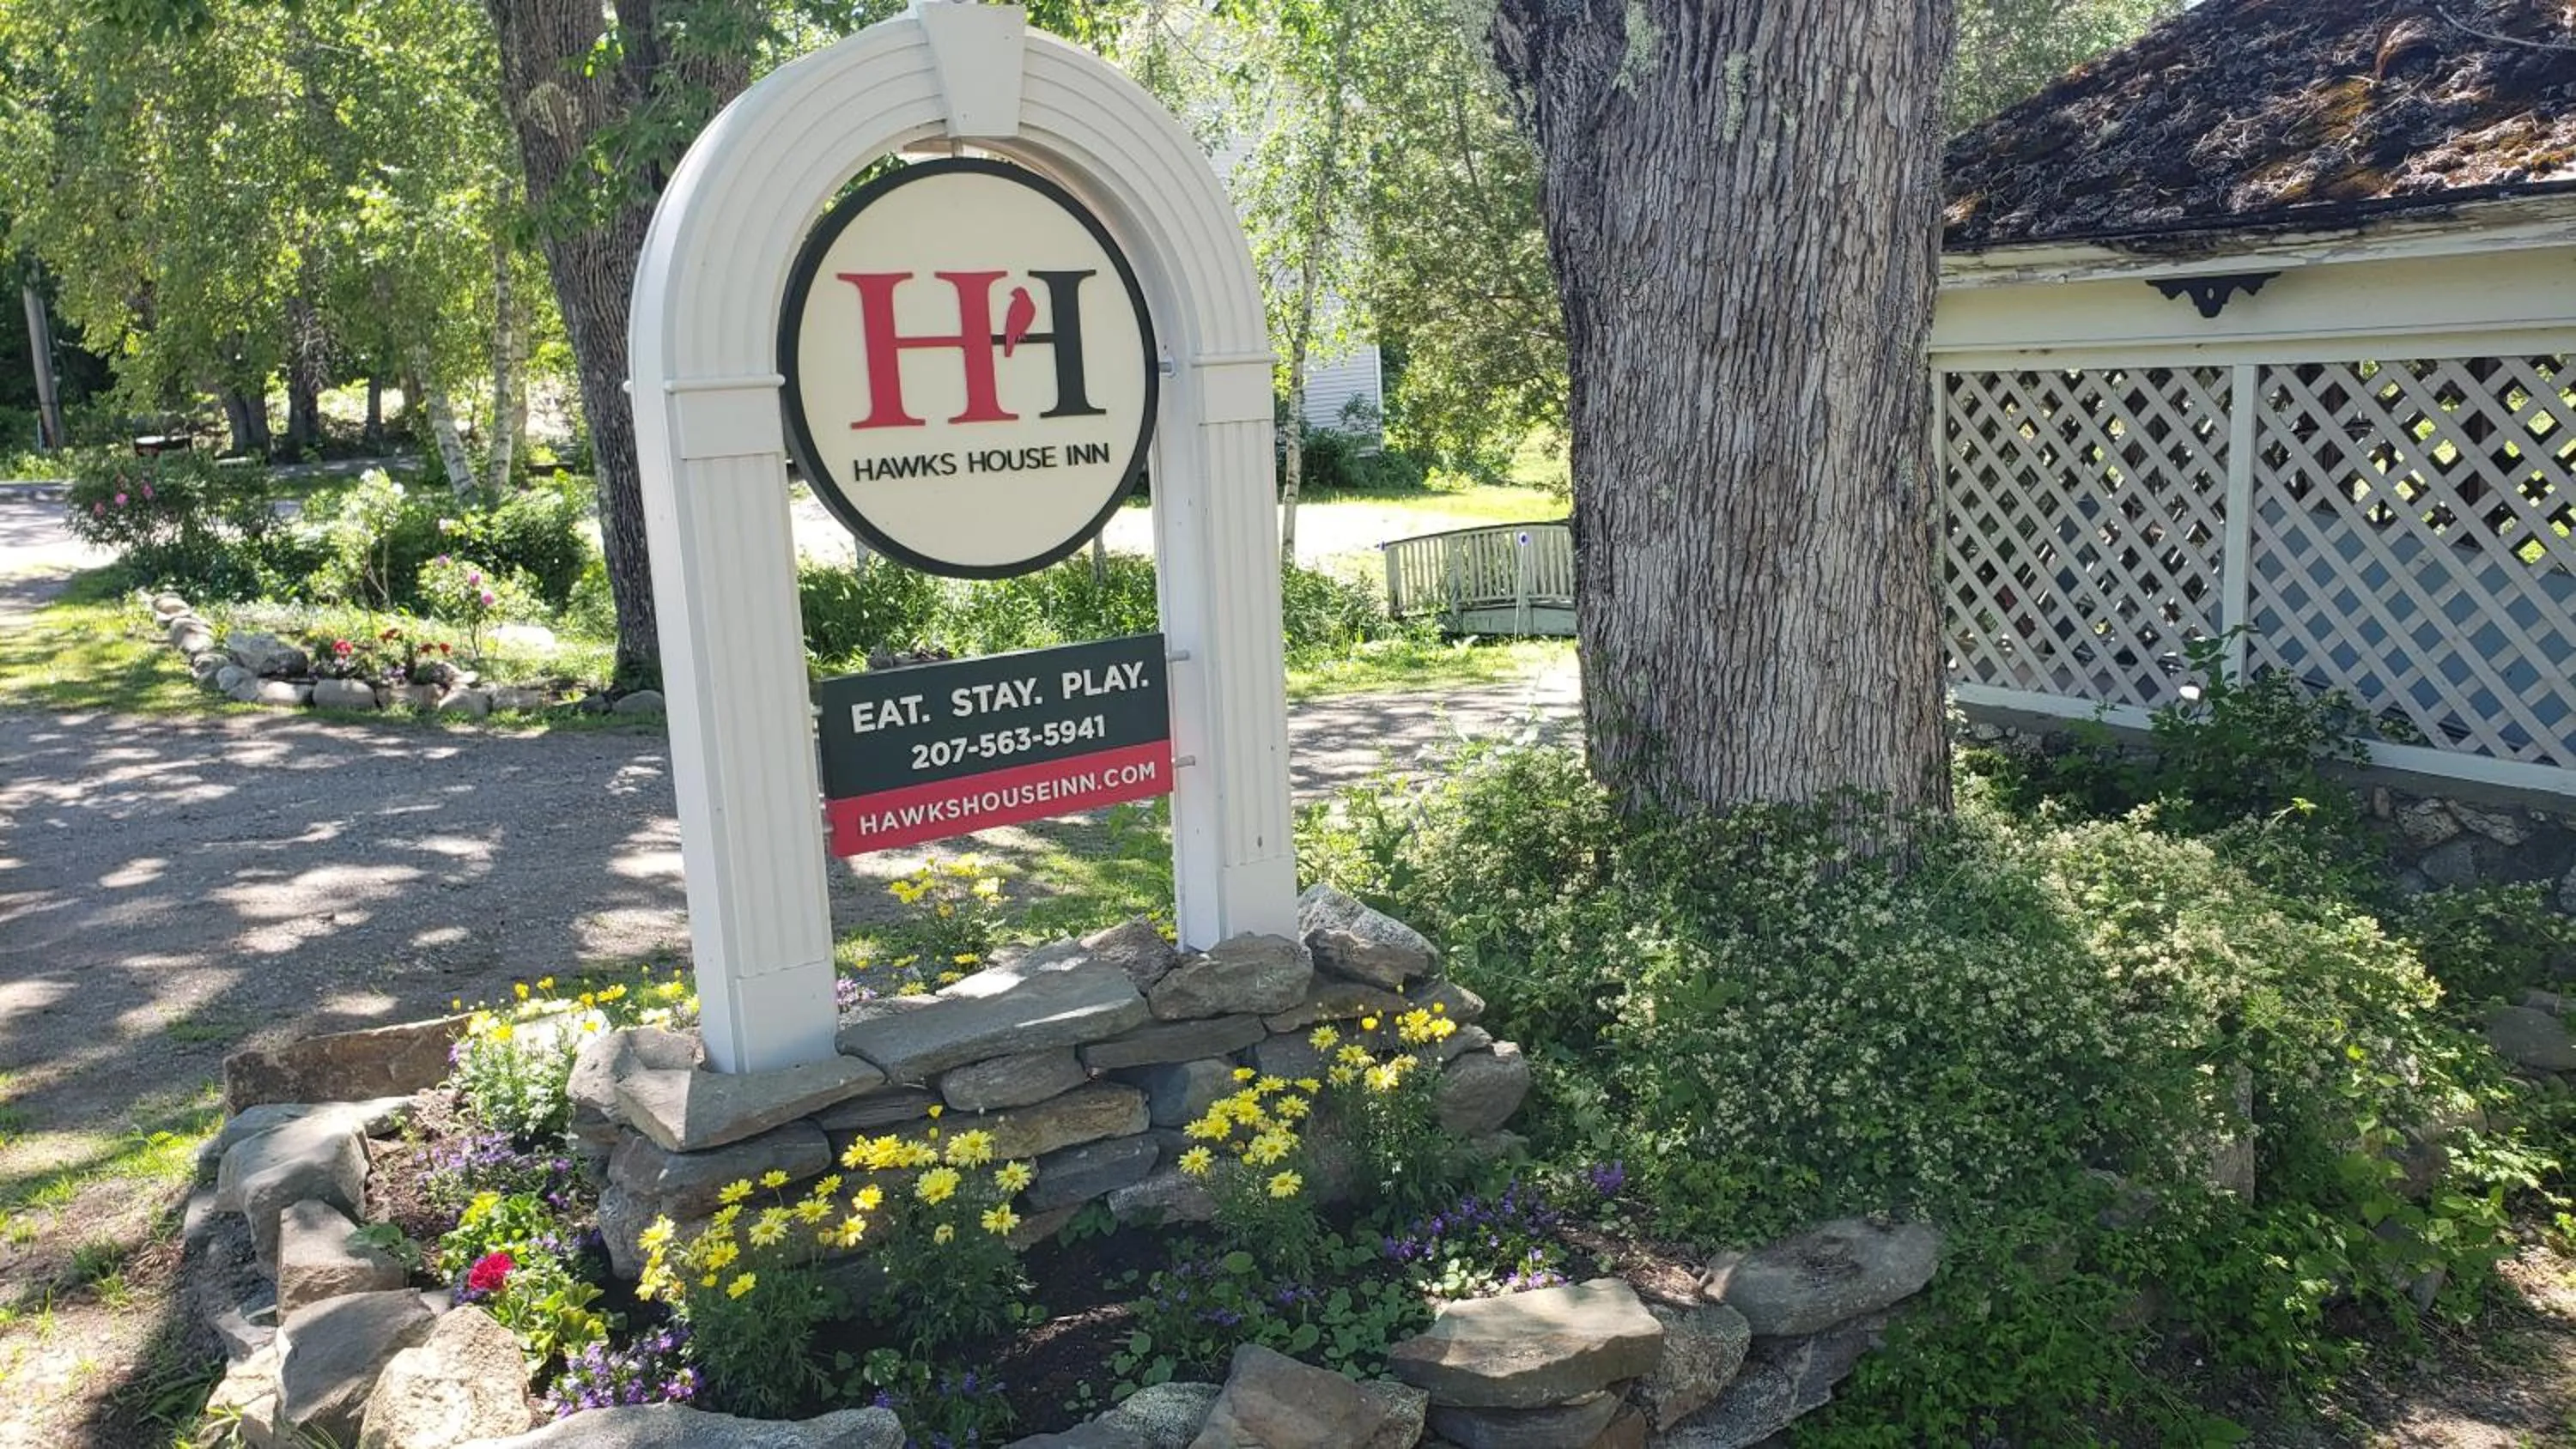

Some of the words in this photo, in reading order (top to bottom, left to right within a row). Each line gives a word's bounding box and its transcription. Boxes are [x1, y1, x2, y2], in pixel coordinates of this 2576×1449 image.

[854, 452, 957, 482] HAWKS
[968, 446, 1057, 474] HOUSE
[1067, 442, 1110, 466] INN
[851, 694, 931, 733] EAT.
[951, 677, 1043, 718] STAY.
[1061, 661, 1149, 700] PLAY.
[912, 714, 1106, 770] 207-563-5941
[860, 761, 1156, 836] HAWKSHOUSEINN.COM
